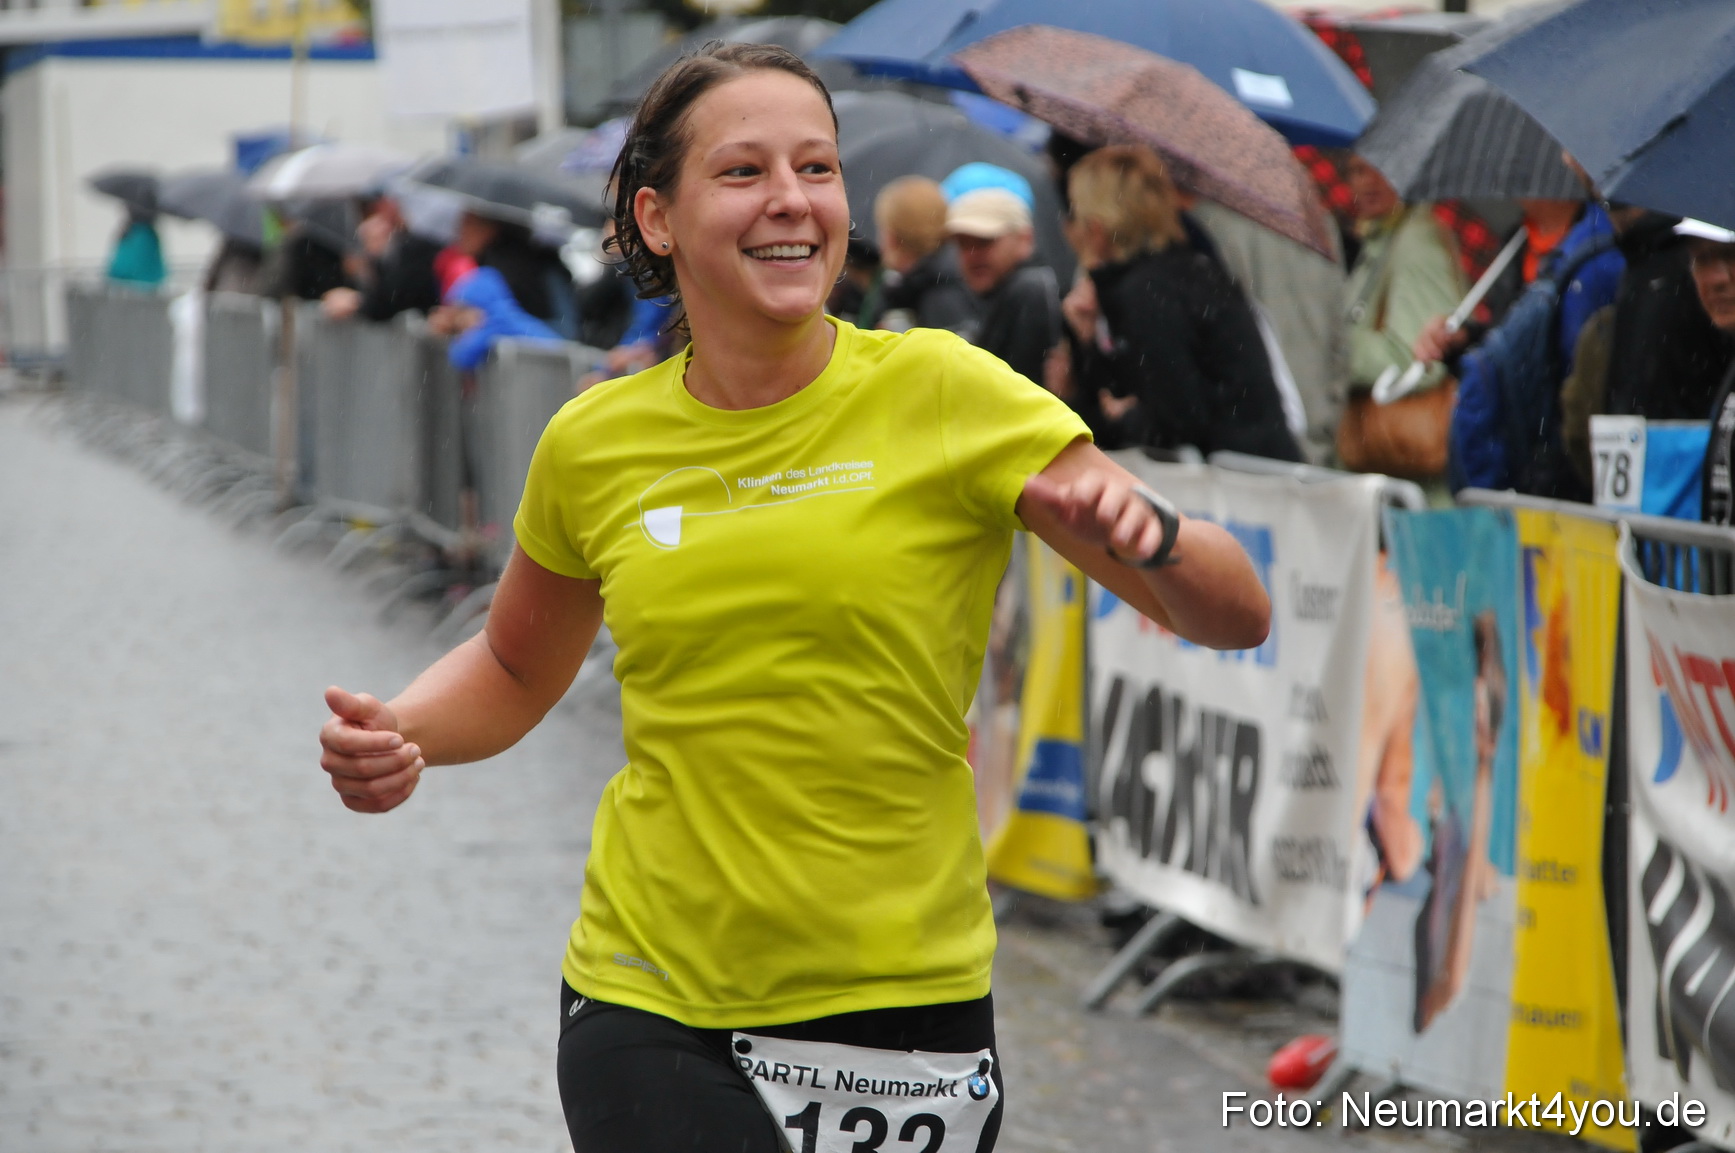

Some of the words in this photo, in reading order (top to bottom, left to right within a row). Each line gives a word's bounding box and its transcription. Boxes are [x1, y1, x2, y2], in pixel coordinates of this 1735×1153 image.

[737, 471, 782, 489] Kliniken
[785, 468, 806, 480] des
[808, 460, 874, 478] Landkreises
[771, 476, 829, 496] Neumarkt
[737, 1056, 827, 1090] PARTL
[834, 1069, 958, 1098] Neumarkt
